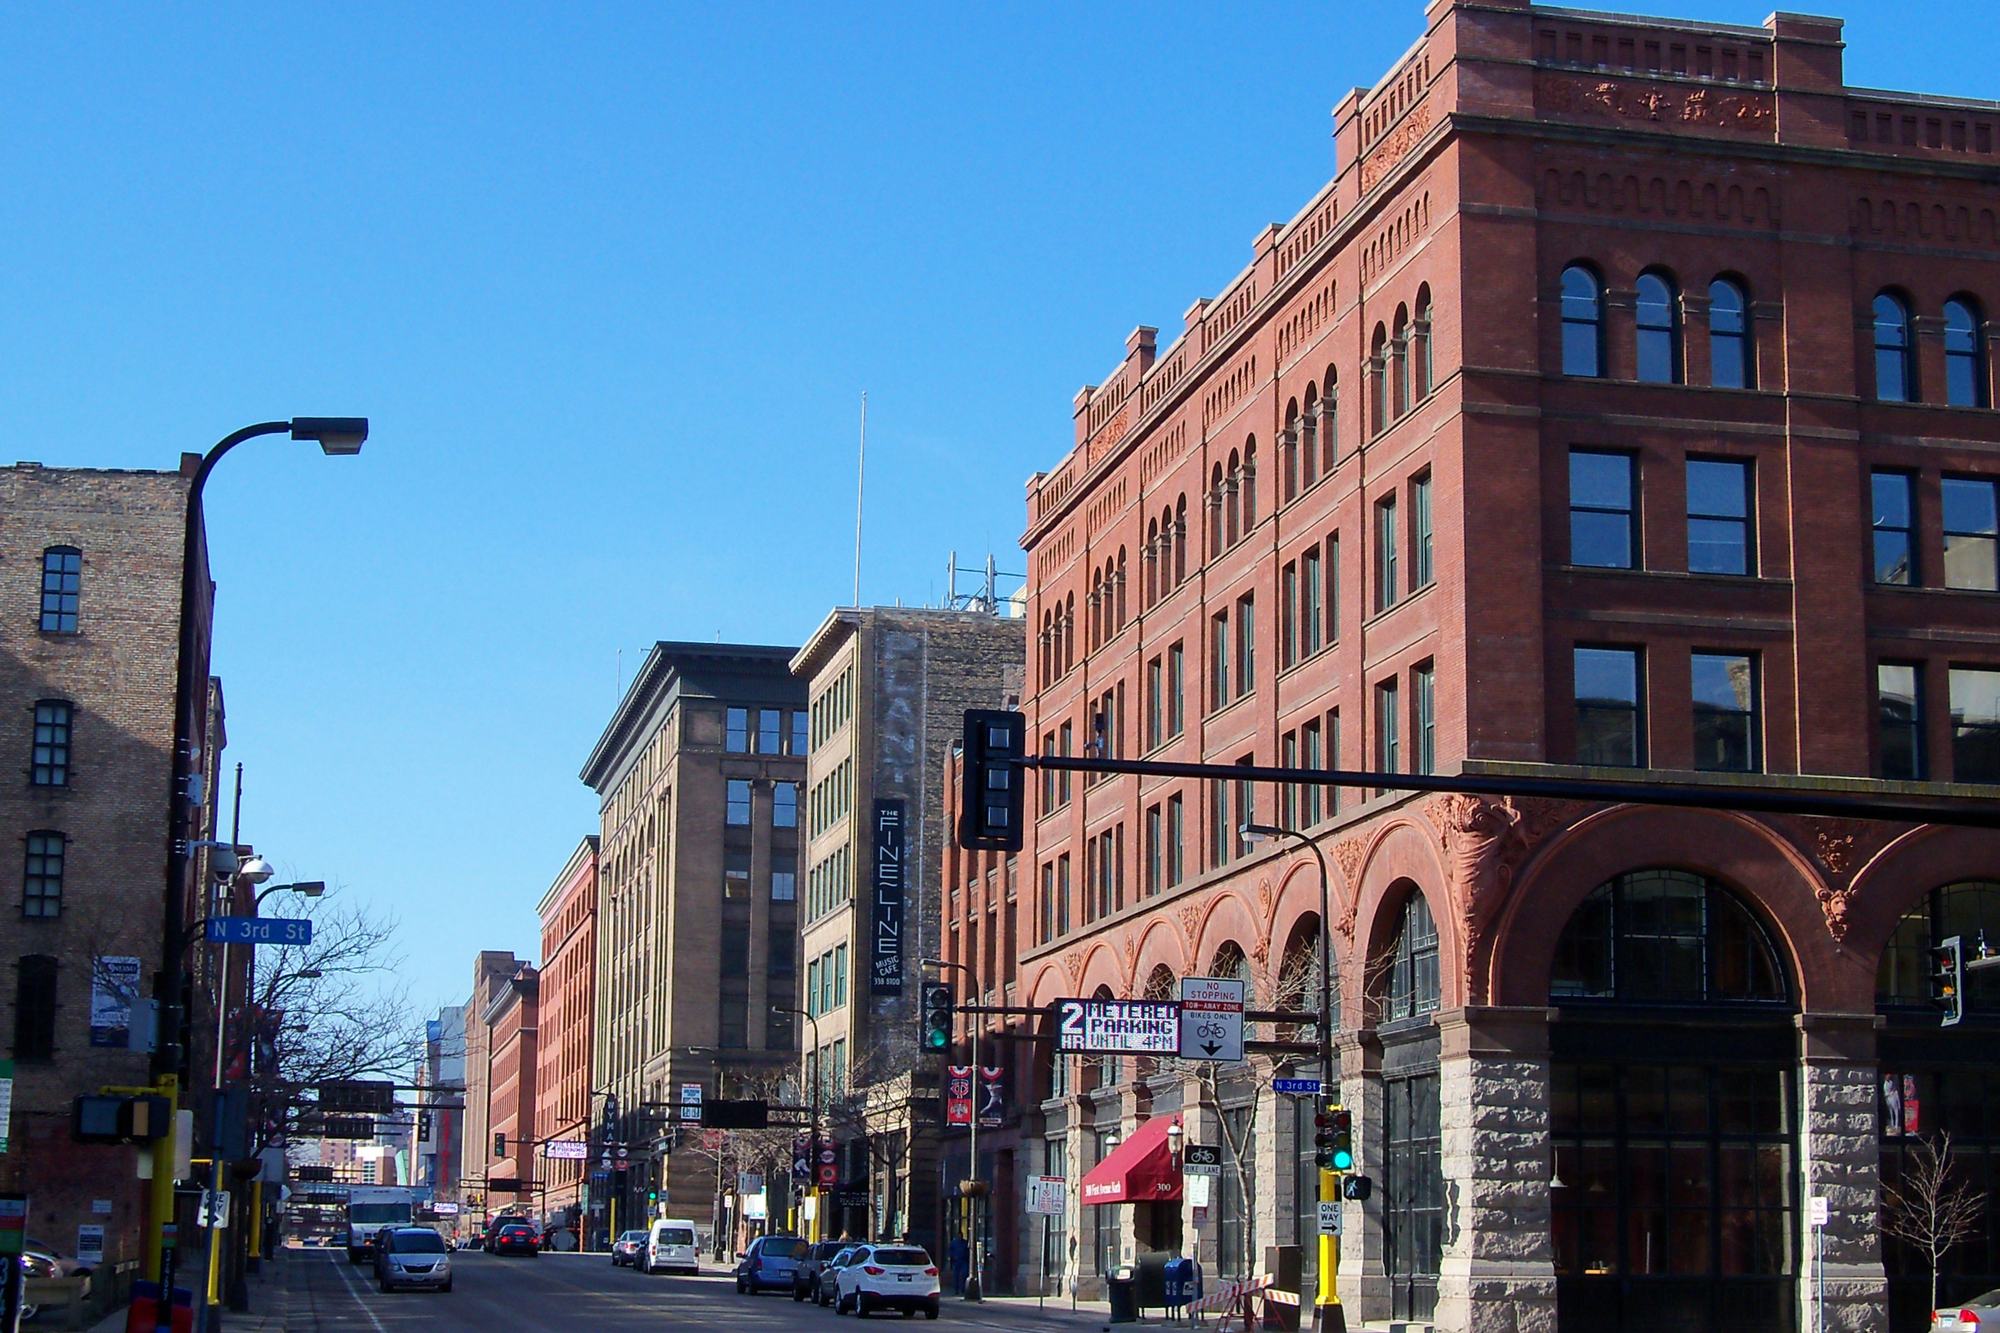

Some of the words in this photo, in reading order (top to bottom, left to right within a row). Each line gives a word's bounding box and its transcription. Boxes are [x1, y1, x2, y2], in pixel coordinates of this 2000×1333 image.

[215, 921, 226, 937] N
[240, 922, 270, 938] 3rd
[285, 923, 305, 940] St
[875, 955, 899, 969] MUSIC
[880, 963, 899, 976] CAFE
[1206, 982, 1219, 990] NO
[1191, 991, 1235, 1000] STOPPING
[1087, 1003, 1177, 1018] METERED
[1185, 1001, 1221, 1010] TOW-AWAY
[1223, 1003, 1240, 1011] ZONE
[1061, 1002, 1084, 1034] 2
[1091, 1019, 1173, 1034] PARKING
[1061, 1034, 1085, 1049] HR
[1090, 1034, 1132, 1048] UNTIL
[1142, 1035, 1173, 1049] 4PM
[1276, 1081, 1282, 1090] N
[1286, 1081, 1303, 1090] 3rd
[1306, 1081, 1317, 1090] St
[1204, 1165, 1219, 1174] LANE
[1156, 1183, 1171, 1191] 300
[1321, 1204, 1339, 1212] ONE
[1321, 1213, 1339, 1221] WAY
